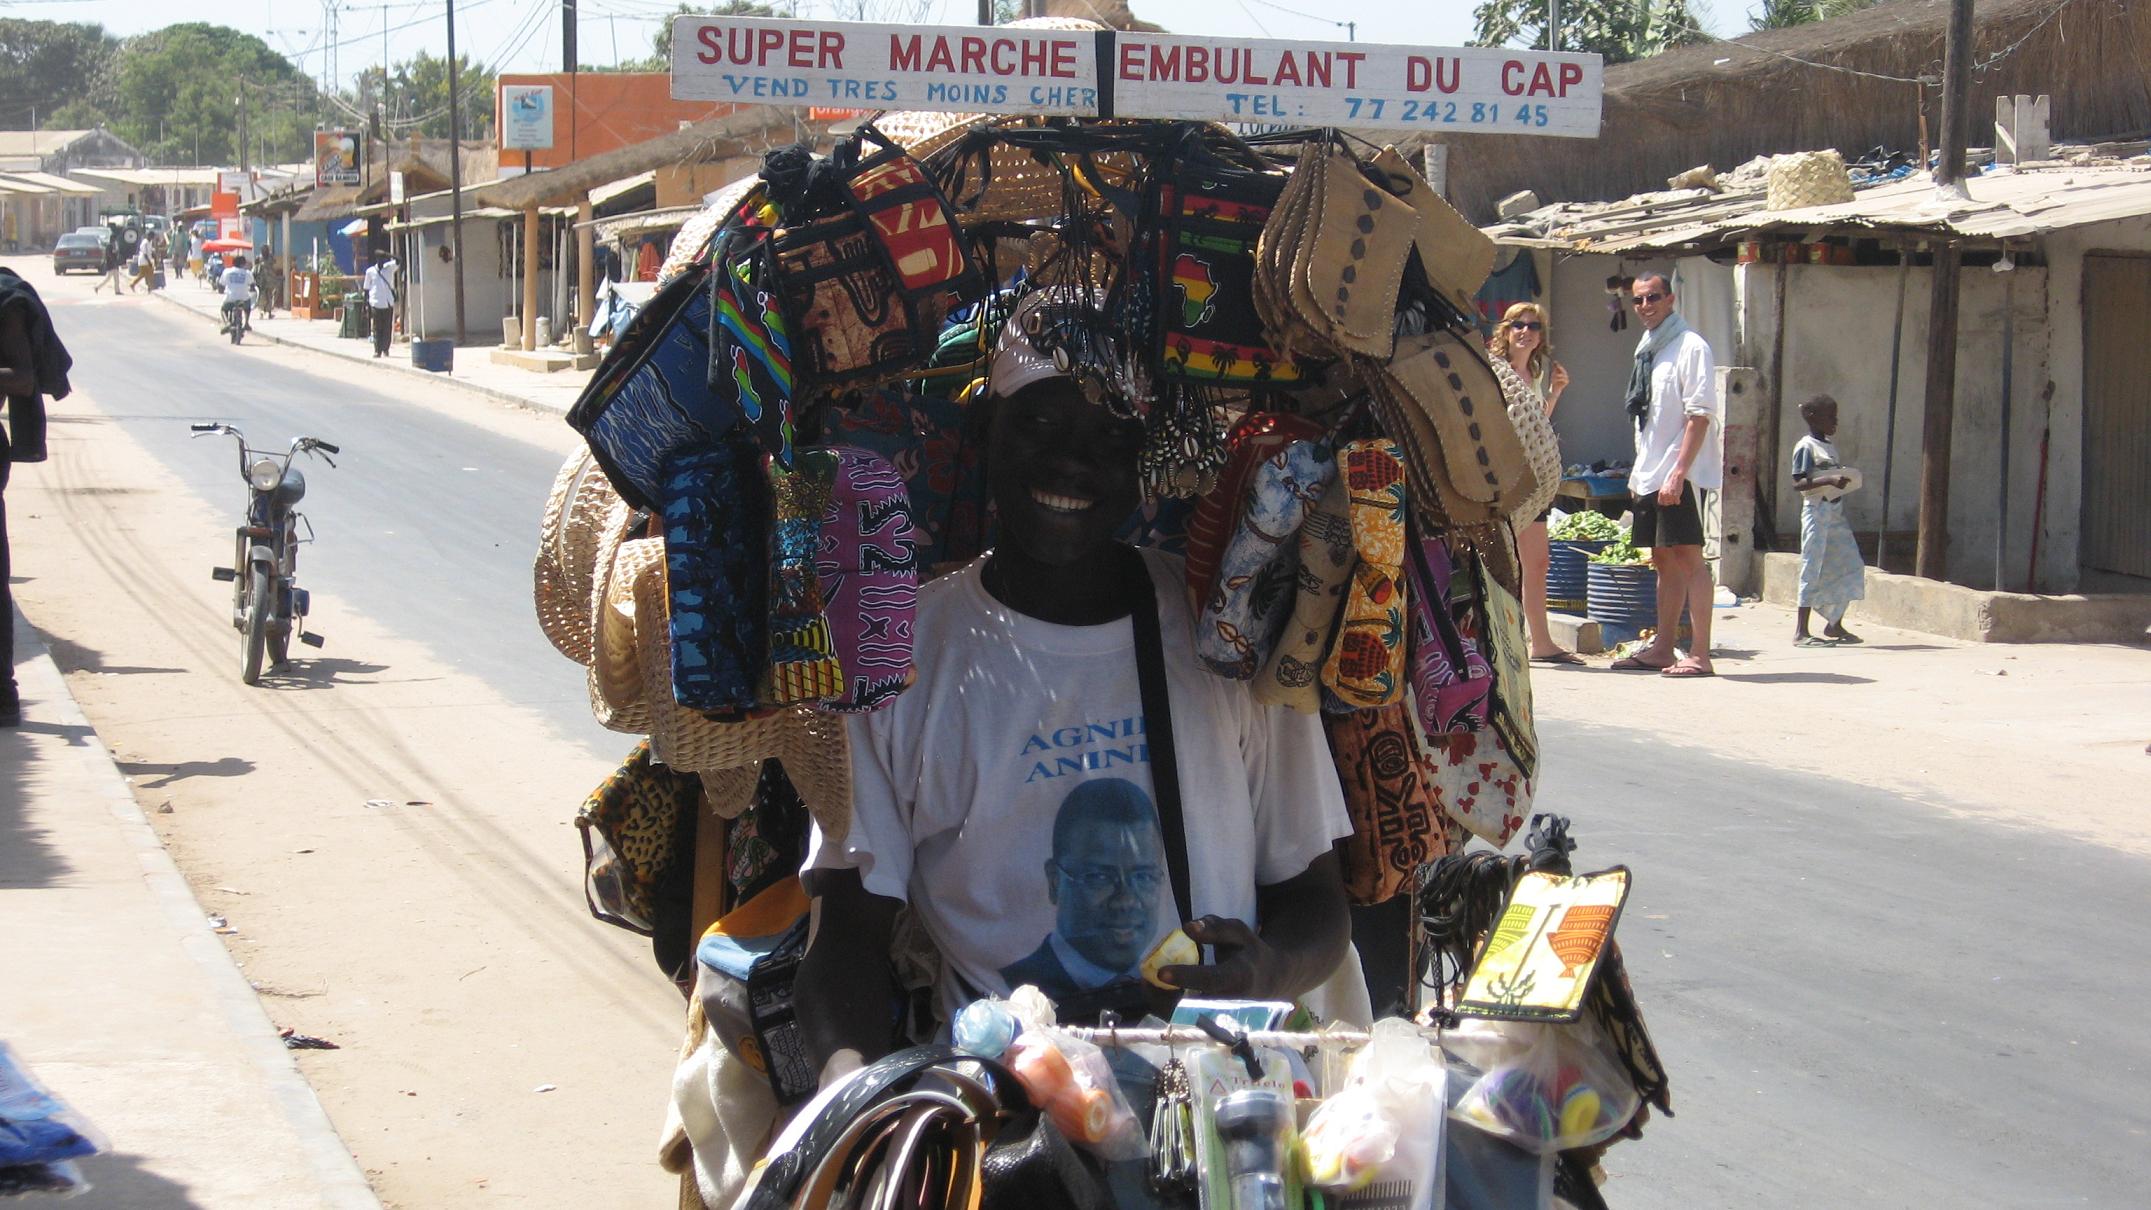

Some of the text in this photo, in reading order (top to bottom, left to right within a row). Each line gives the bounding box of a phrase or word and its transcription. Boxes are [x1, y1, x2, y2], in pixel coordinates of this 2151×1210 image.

[697, 25, 1584, 98] SUPER MARCHE EMBULANT DU CAP
[723, 75, 1096, 108] VEND TRES MOINS CHER
[1226, 93, 1550, 127] TEL: 77 242 81 45
